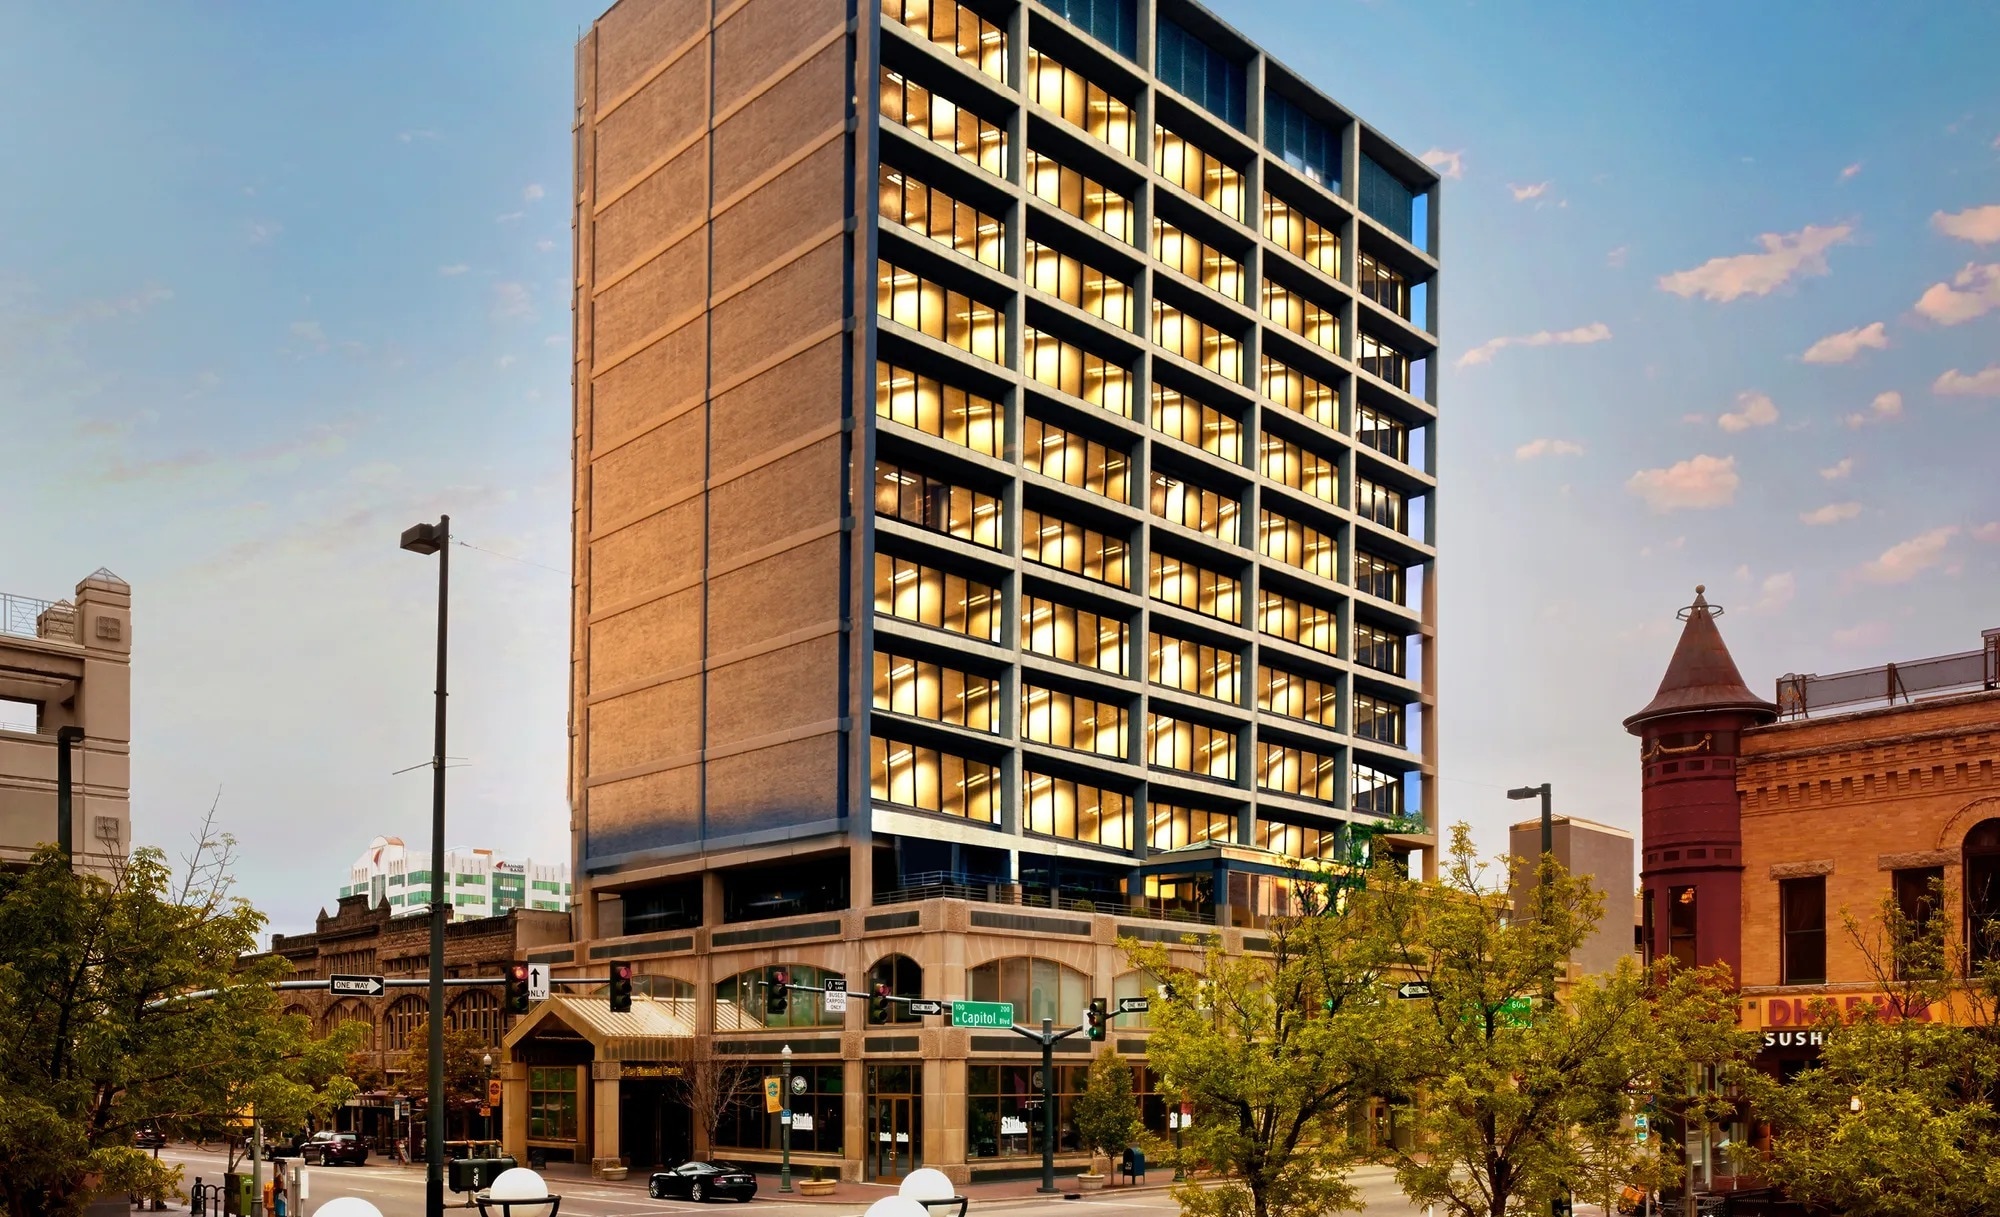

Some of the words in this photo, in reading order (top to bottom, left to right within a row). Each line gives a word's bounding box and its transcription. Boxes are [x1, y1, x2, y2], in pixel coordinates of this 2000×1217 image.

[336, 981, 350, 989] ONE
[528, 990, 546, 998] NLY
[1000, 1005, 1010, 1013] 200
[961, 1011, 996, 1026] Capitol
[999, 1017, 1010, 1025] Blvd
[1765, 1032, 1829, 1047] SUSH
